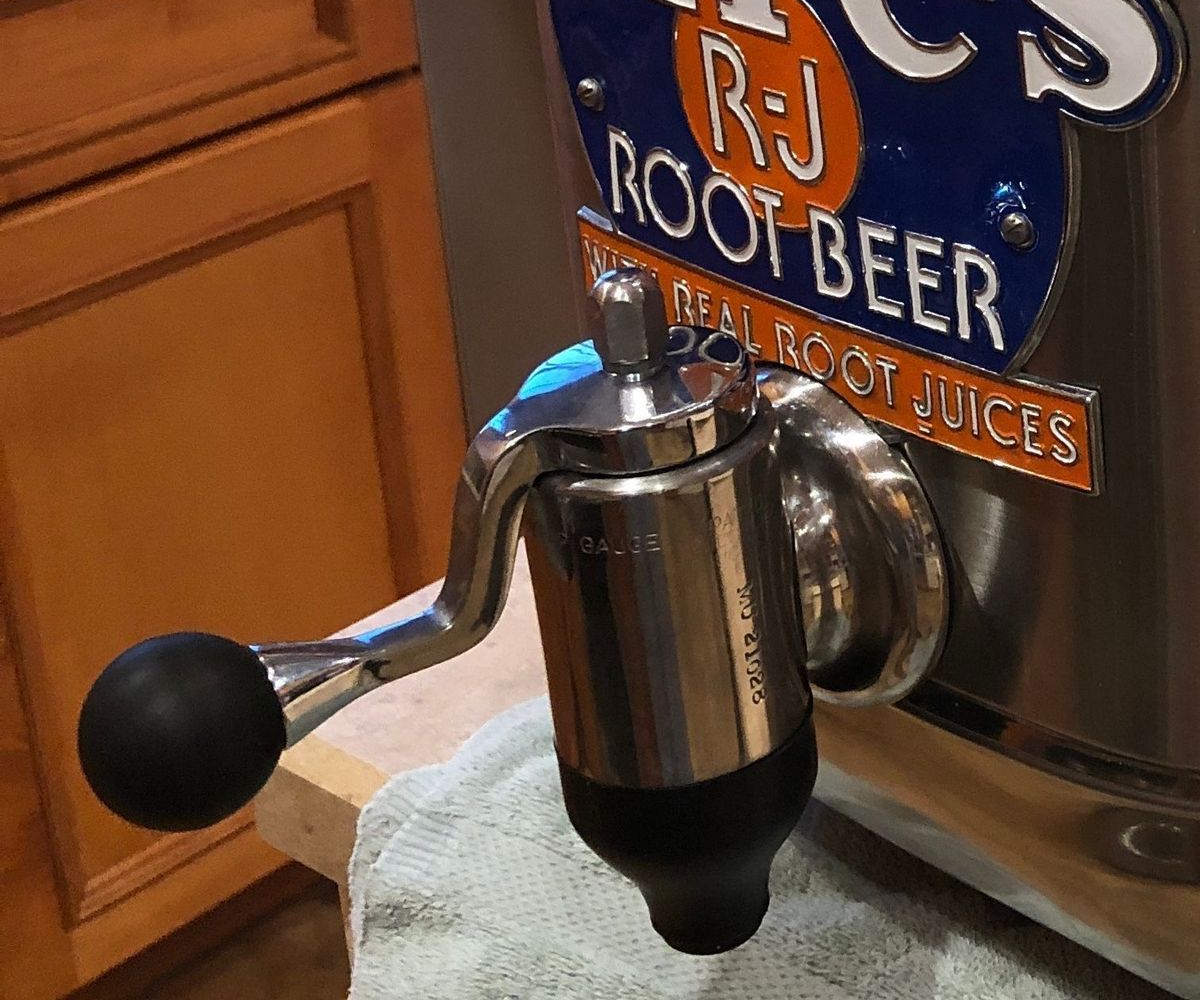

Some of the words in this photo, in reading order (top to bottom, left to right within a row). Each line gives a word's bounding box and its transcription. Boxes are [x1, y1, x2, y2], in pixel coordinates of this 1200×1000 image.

[699, 26, 825, 183] R-J
[607, 125, 784, 281] ROOT
[806, 201, 1005, 353] BEER
[673, 279, 762, 357] REAL
[775, 316, 900, 406] ROOT
[911, 370, 1080, 466] JUICES
